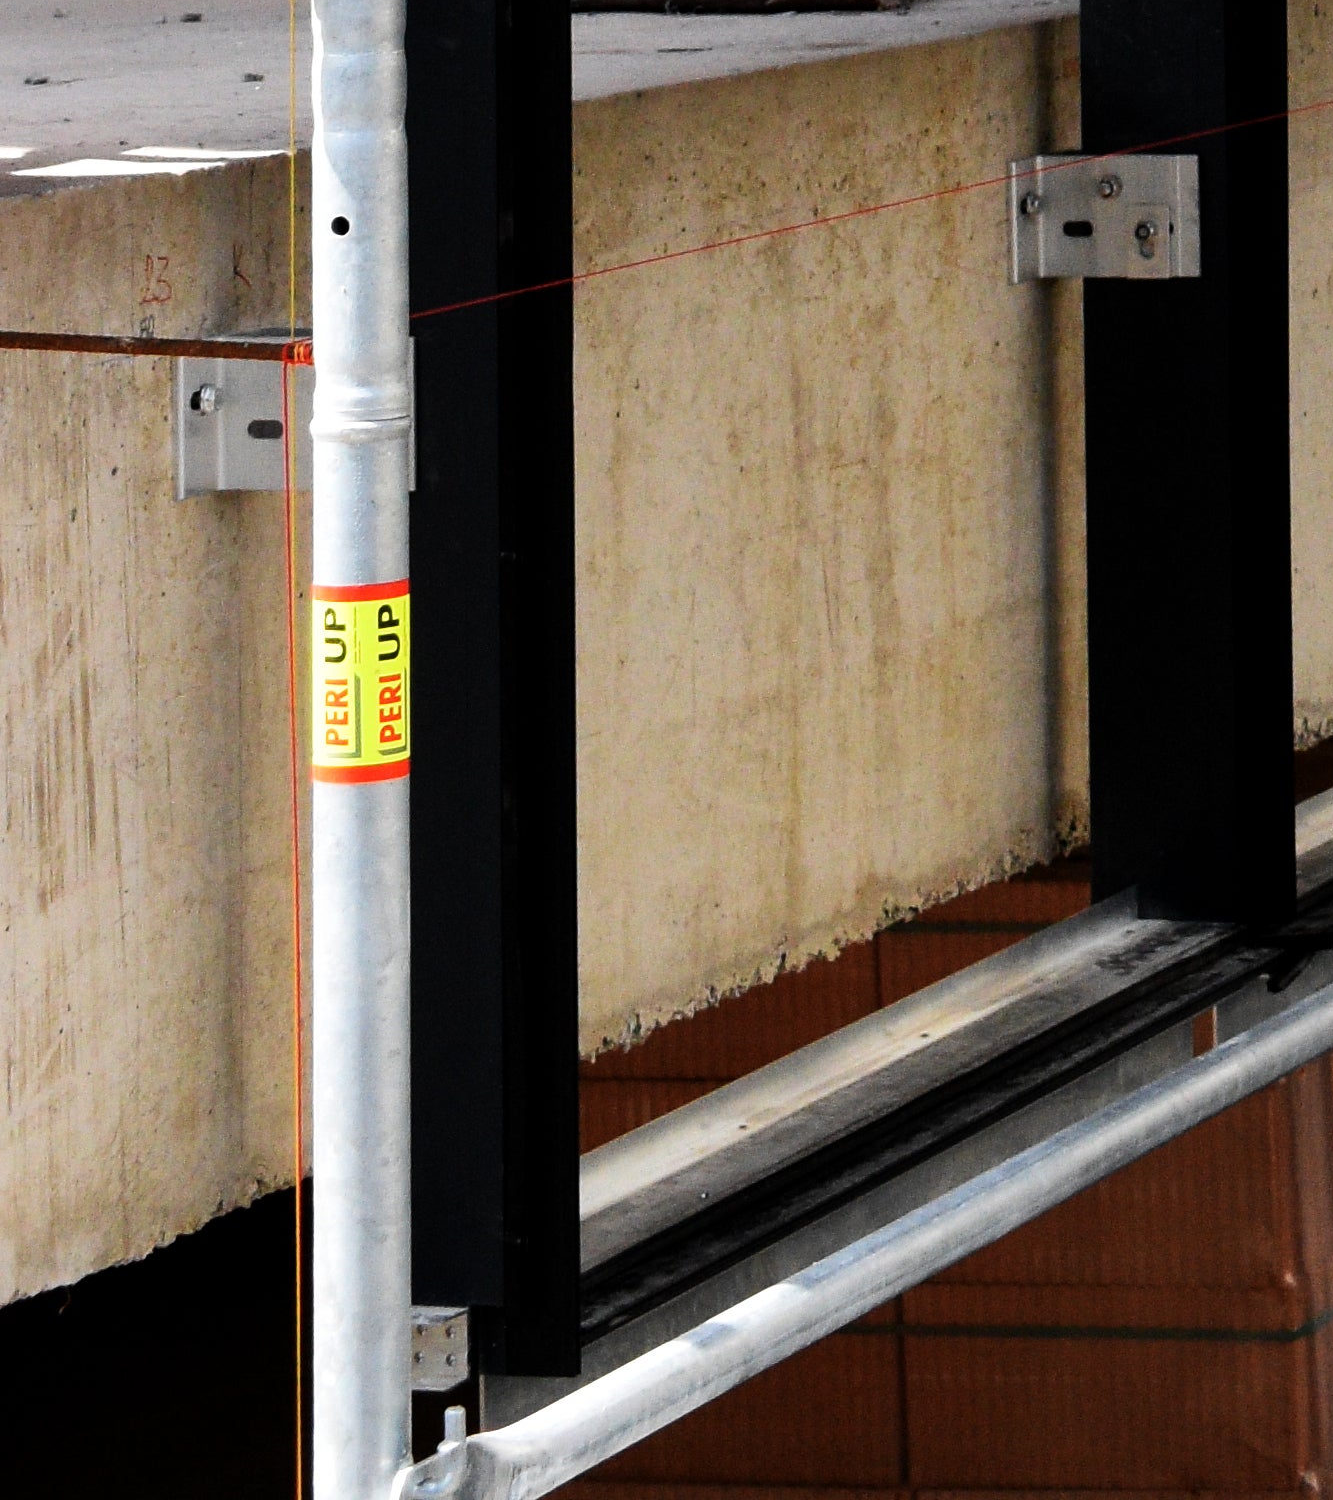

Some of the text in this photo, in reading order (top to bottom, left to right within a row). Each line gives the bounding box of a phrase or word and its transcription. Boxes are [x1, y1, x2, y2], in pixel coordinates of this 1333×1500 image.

[324, 607, 349, 746] PERI UP
[377, 603, 402, 744] PERI UP
